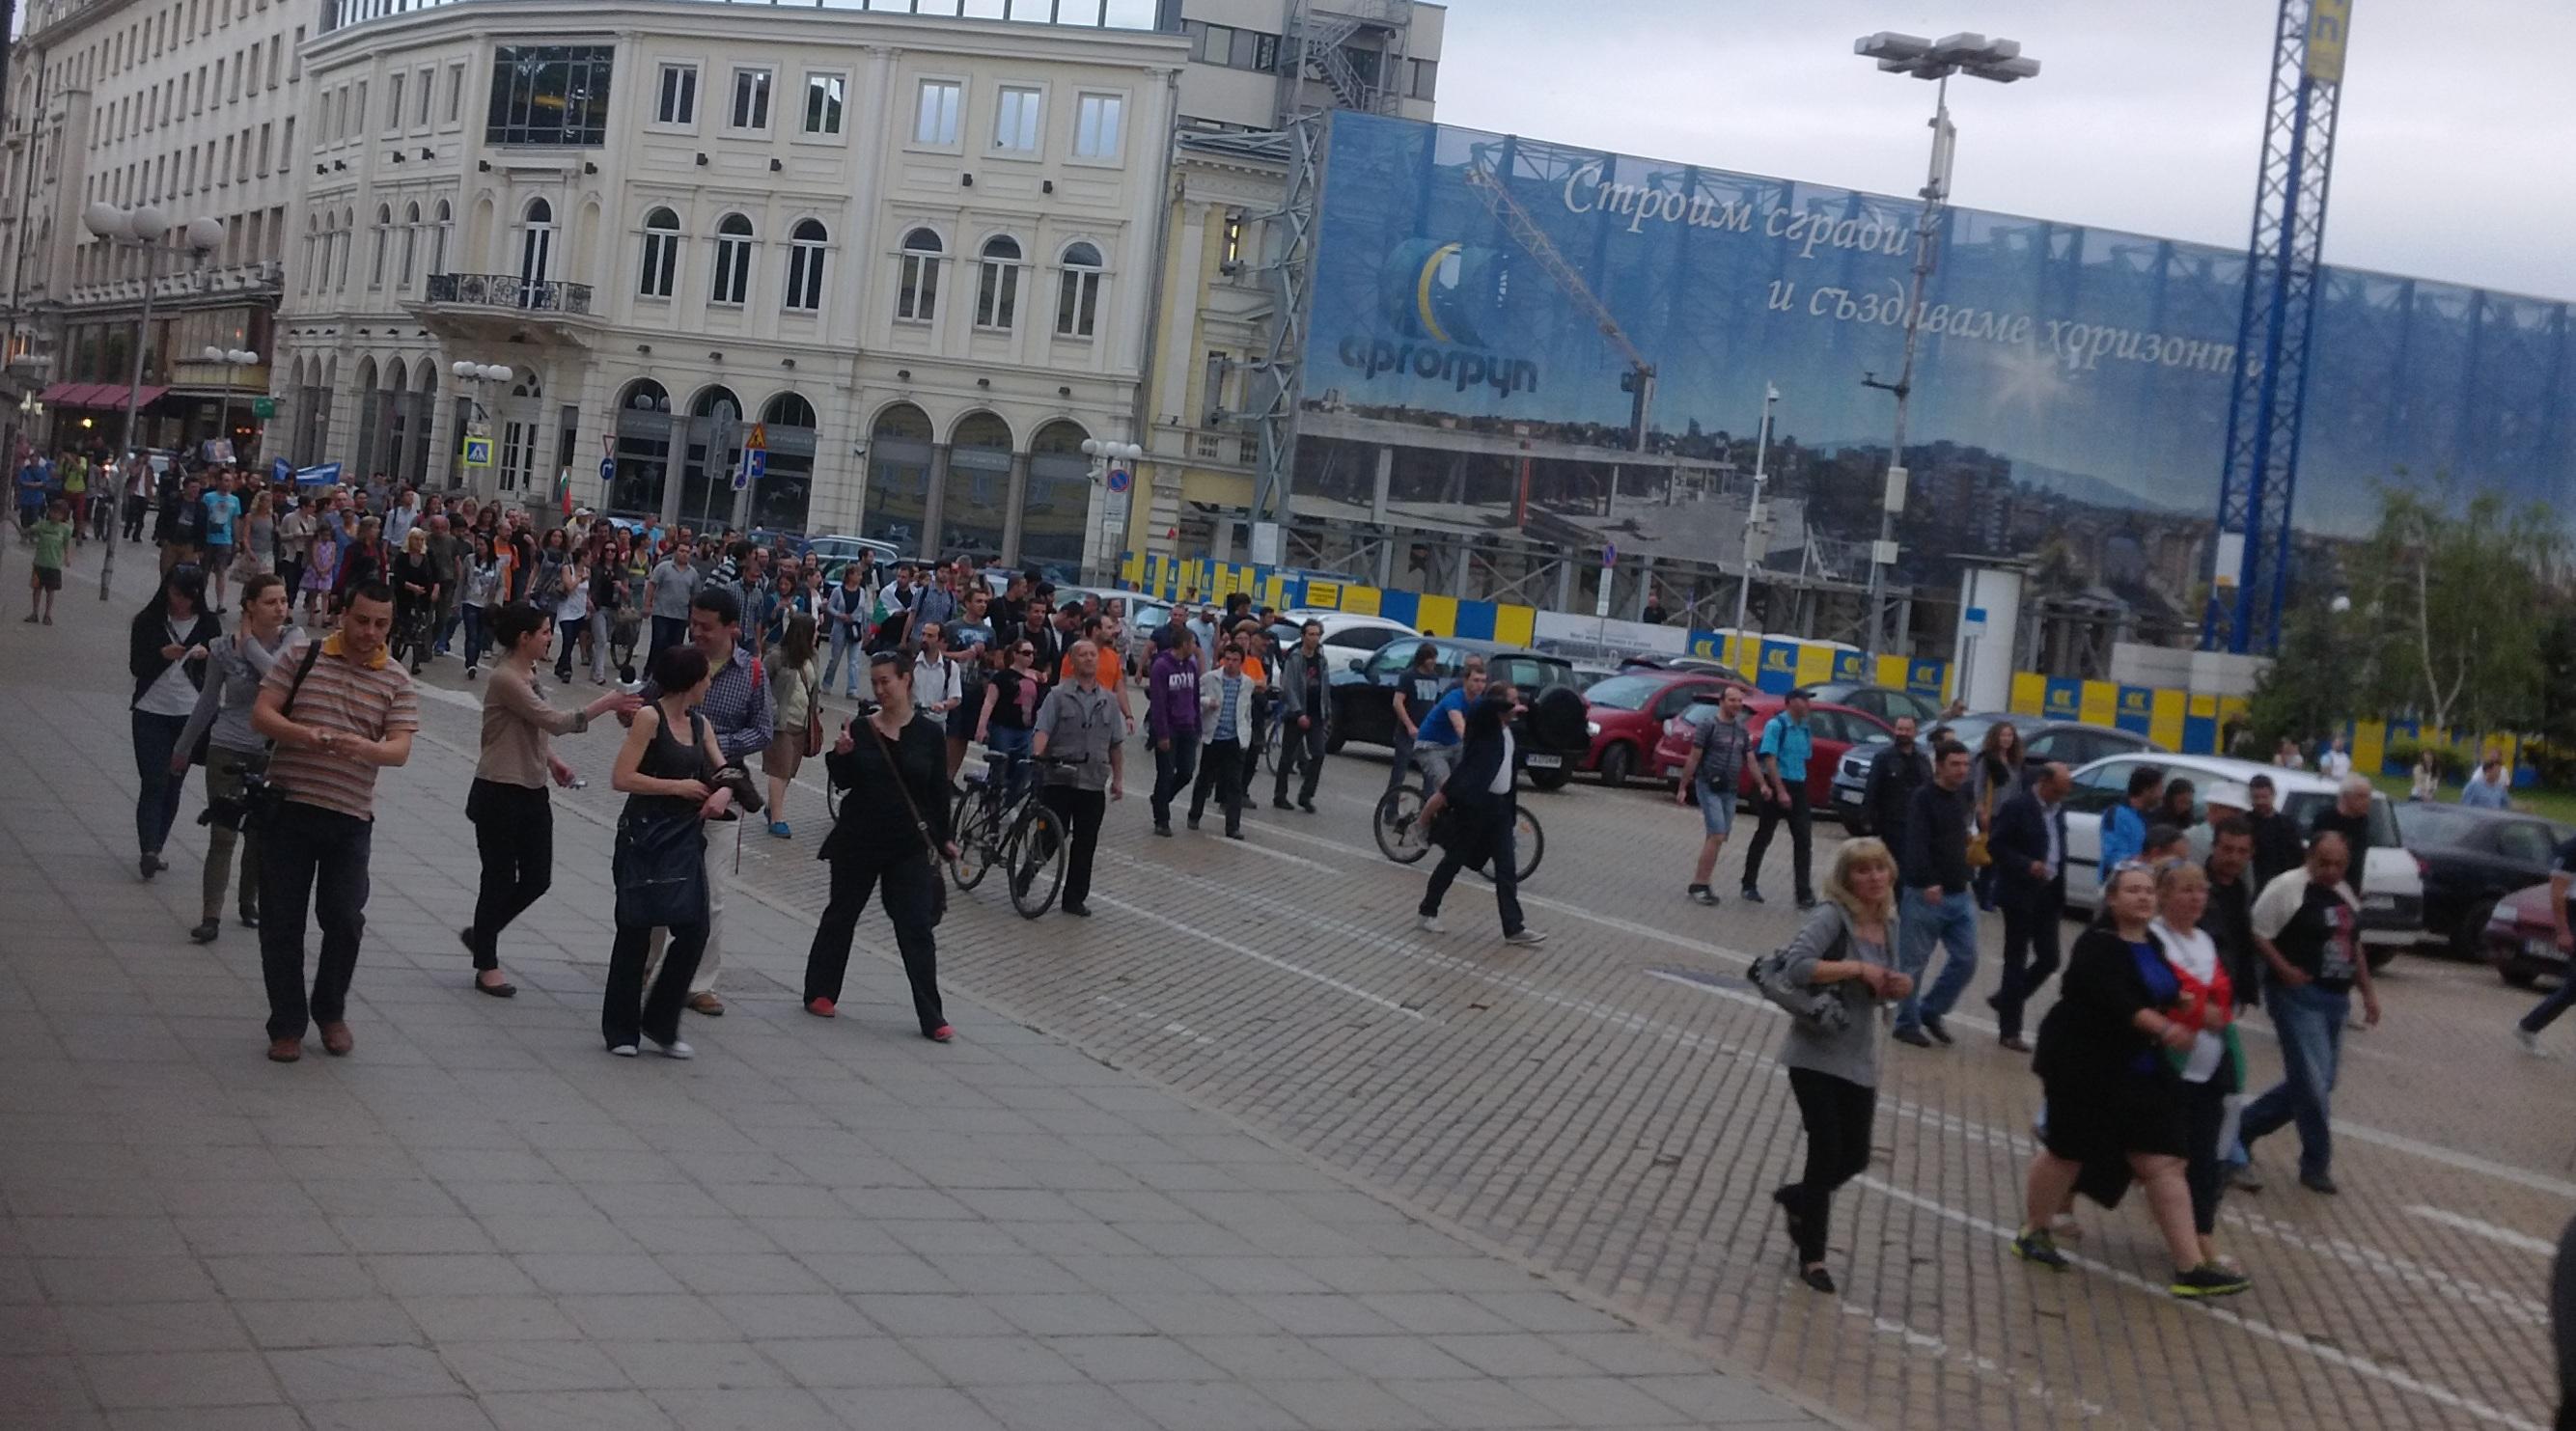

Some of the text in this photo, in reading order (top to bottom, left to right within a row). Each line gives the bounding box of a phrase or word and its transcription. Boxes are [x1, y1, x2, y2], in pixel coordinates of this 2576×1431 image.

[1564, 164, 1910, 260] Строим сгради
[1767, 278, 1792, 312] и
[1809, 278, 2029, 344] създаваме
